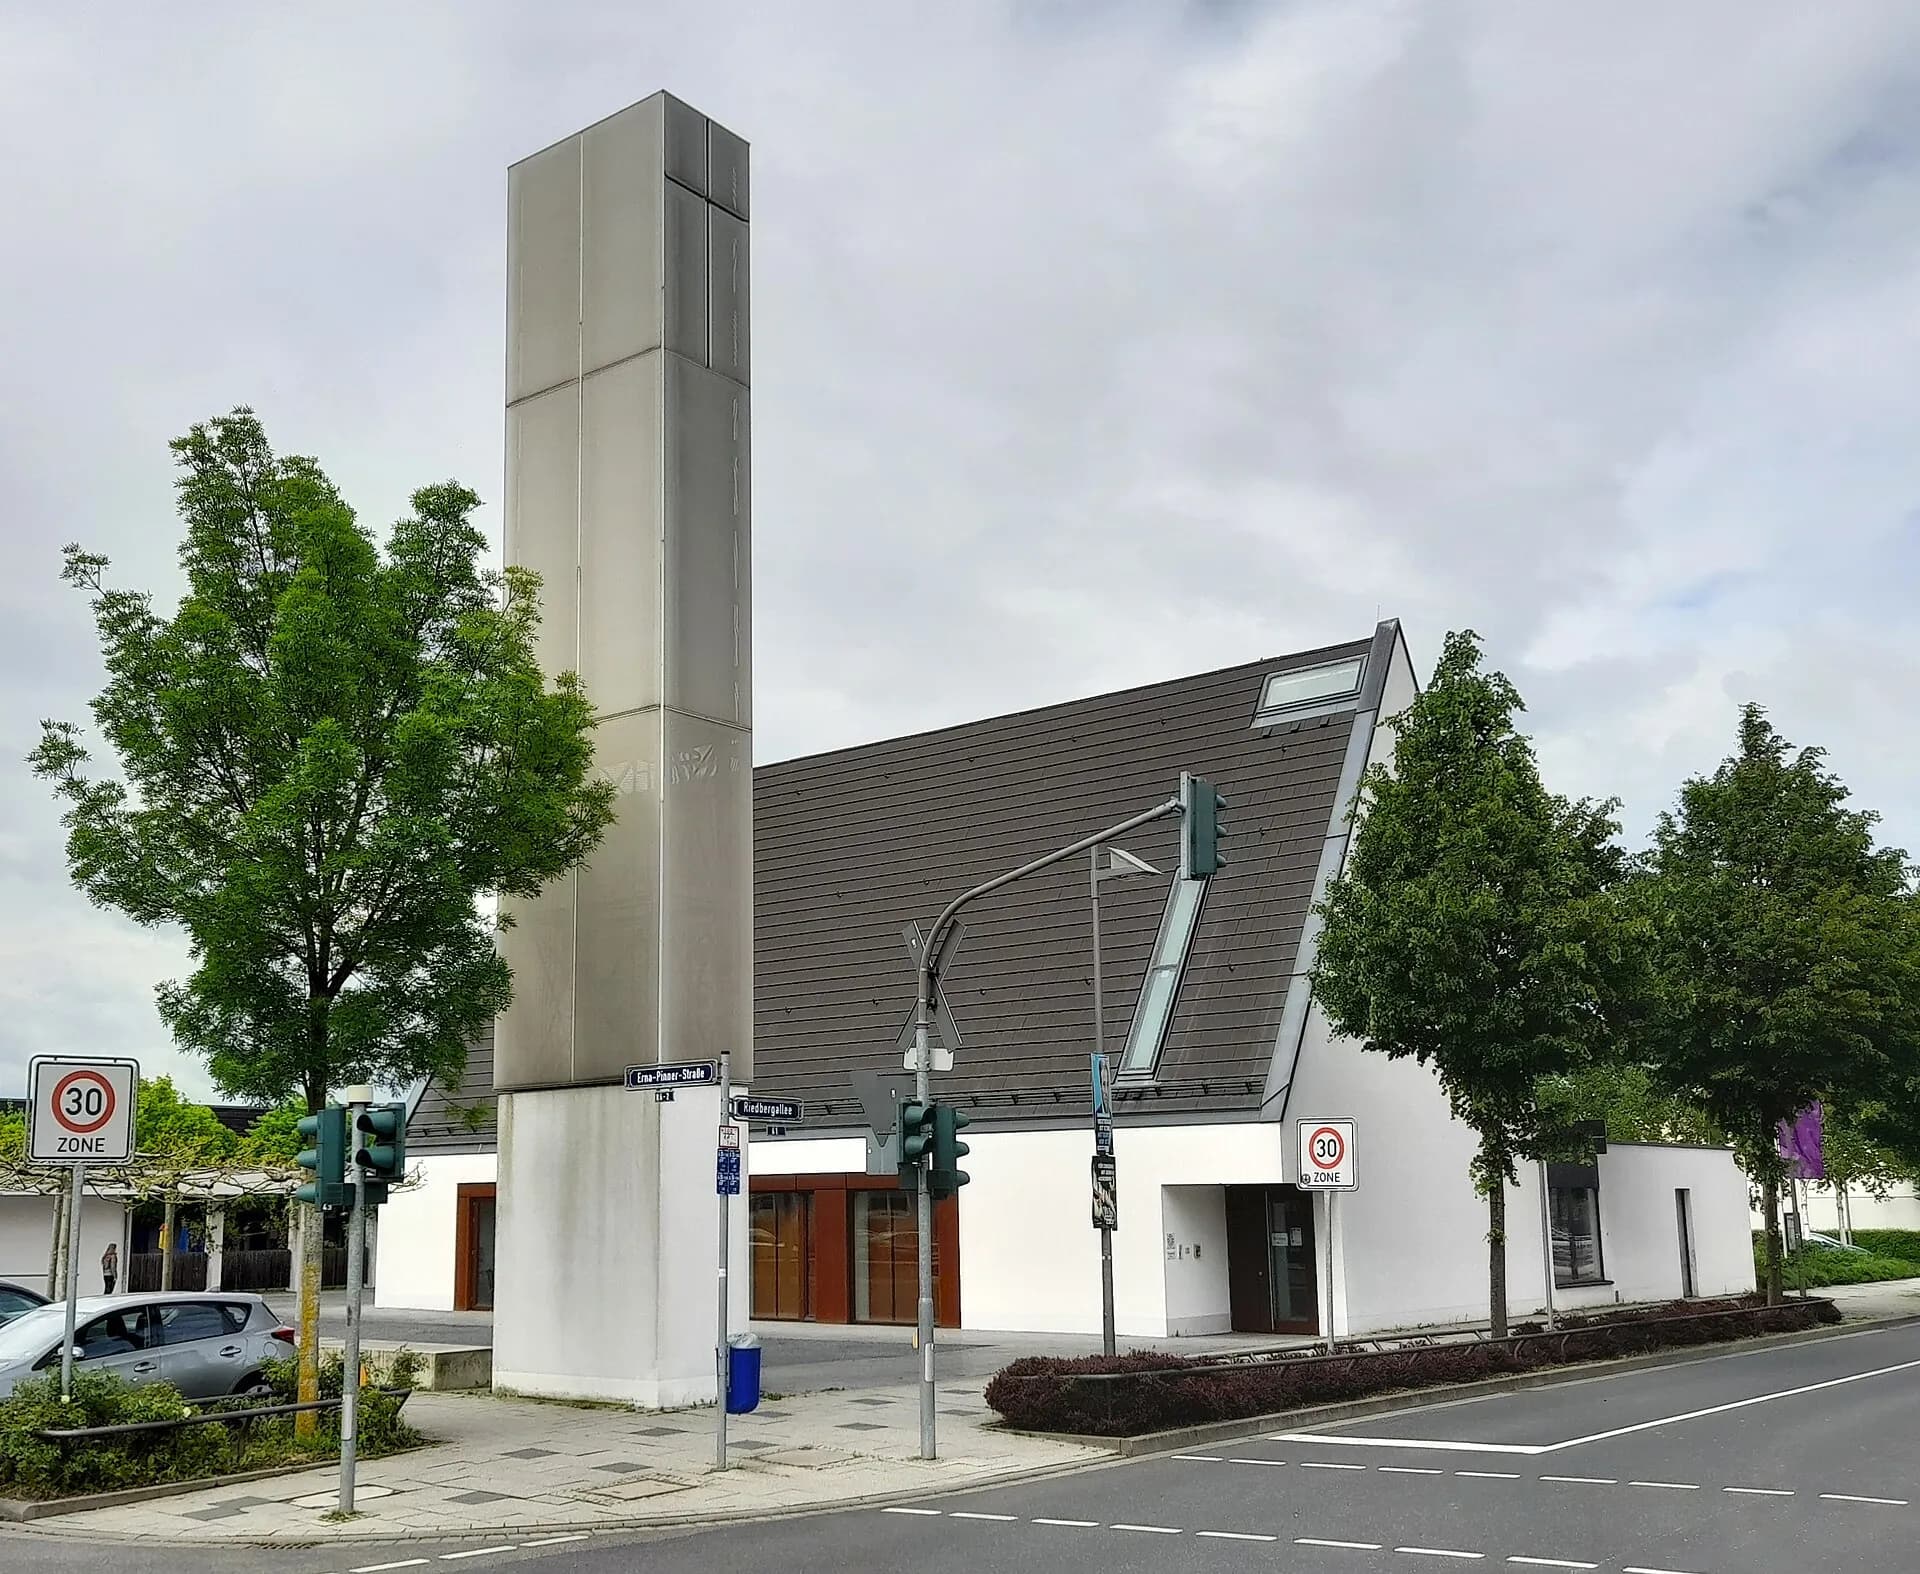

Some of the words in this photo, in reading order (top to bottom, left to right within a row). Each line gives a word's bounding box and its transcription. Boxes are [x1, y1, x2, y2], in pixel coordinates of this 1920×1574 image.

[637, 1067, 705, 1084] Erna-Pinner-Straße
[65, 1087, 103, 1116] 30
[743, 1101, 793, 1117] Riedbergallee
[56, 1137, 106, 1153] ZONE
[1316, 1139, 1338, 1158] 30
[1313, 1172, 1341, 1183] ZONE
